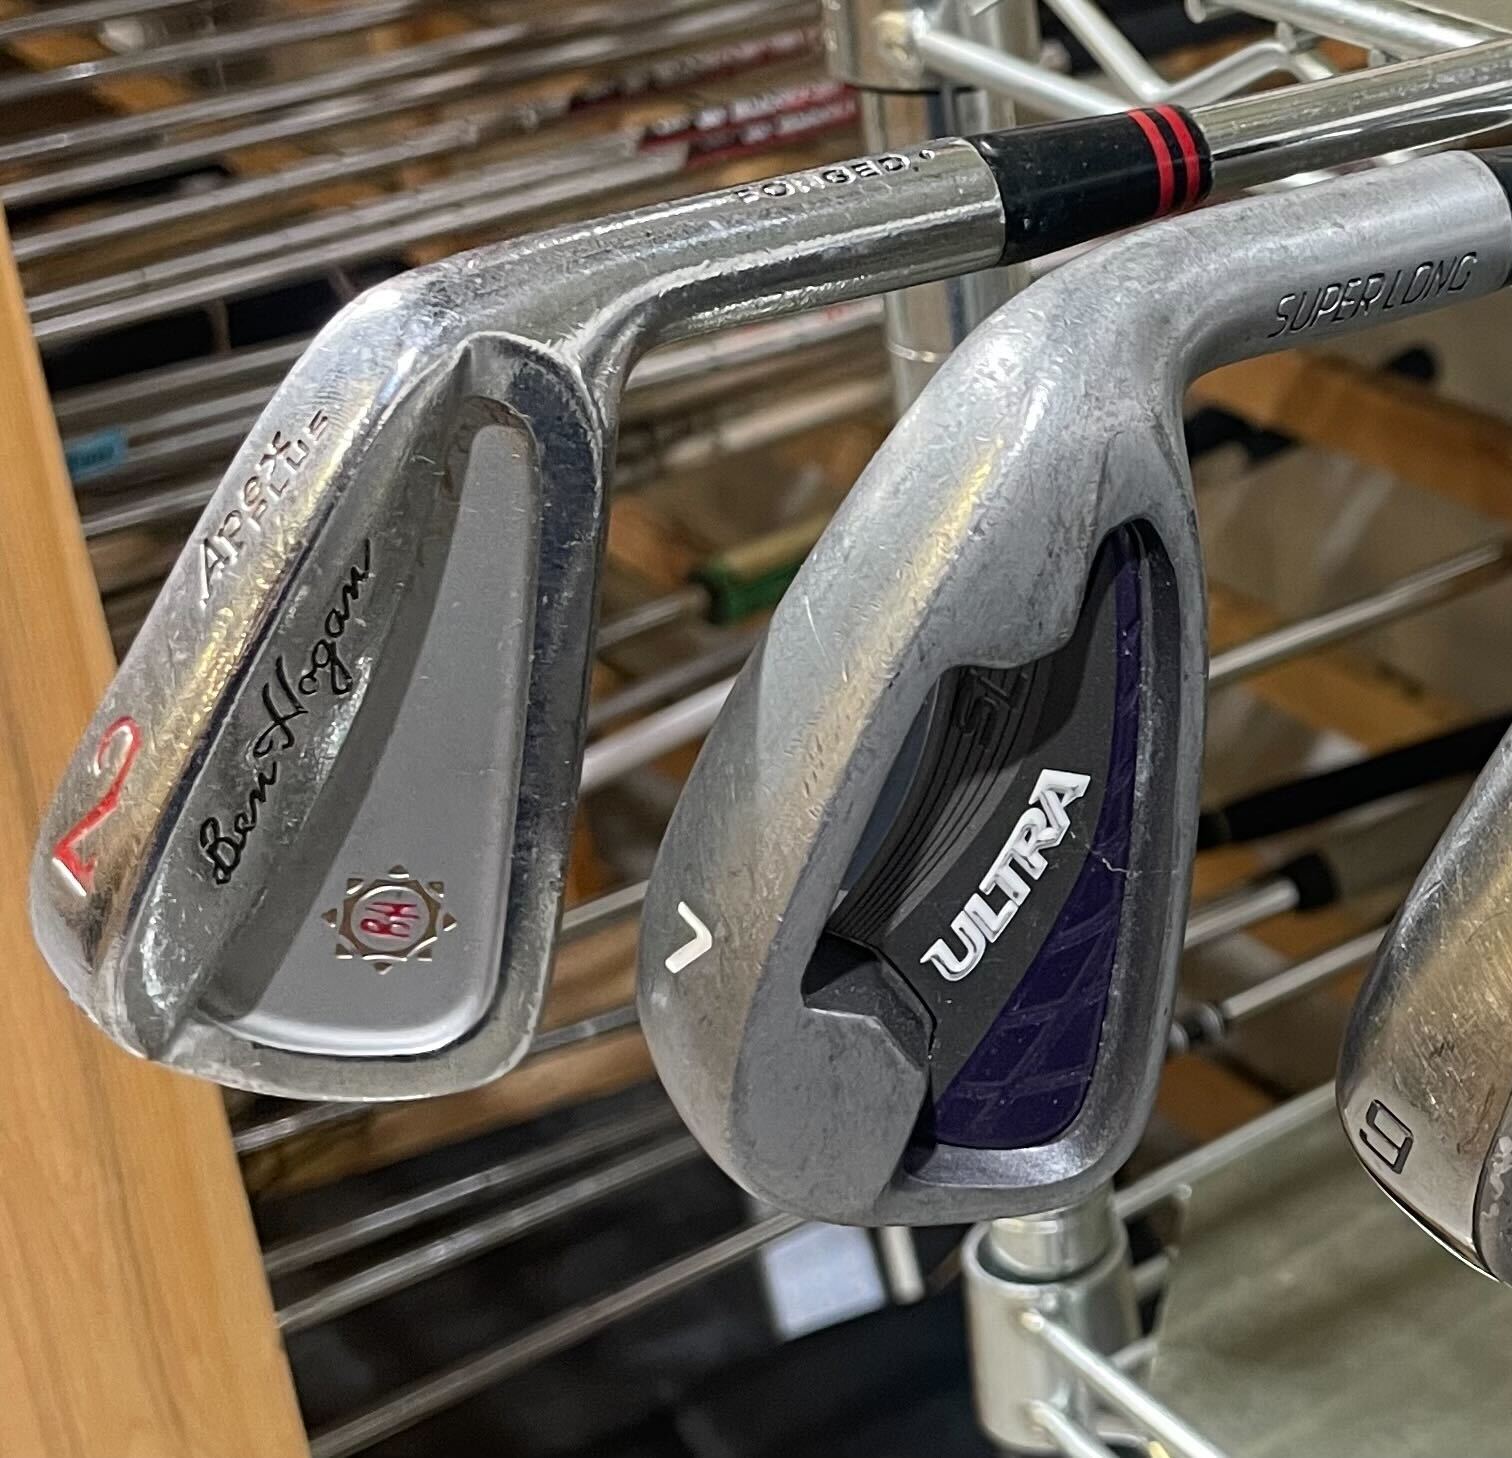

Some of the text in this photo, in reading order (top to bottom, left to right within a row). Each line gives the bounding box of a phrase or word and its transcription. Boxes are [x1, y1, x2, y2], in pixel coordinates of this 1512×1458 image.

[1266, 250, 1478, 339] SUPER LONG
[249, 408, 329, 533] PLUS
[199, 537, 372, 885] Ben Hogan
[52, 715, 142, 897] 2
[665, 900, 713, 974] 7
[920, 768, 1091, 982] ULTRA
[1357, 1098, 1415, 1175] 9
